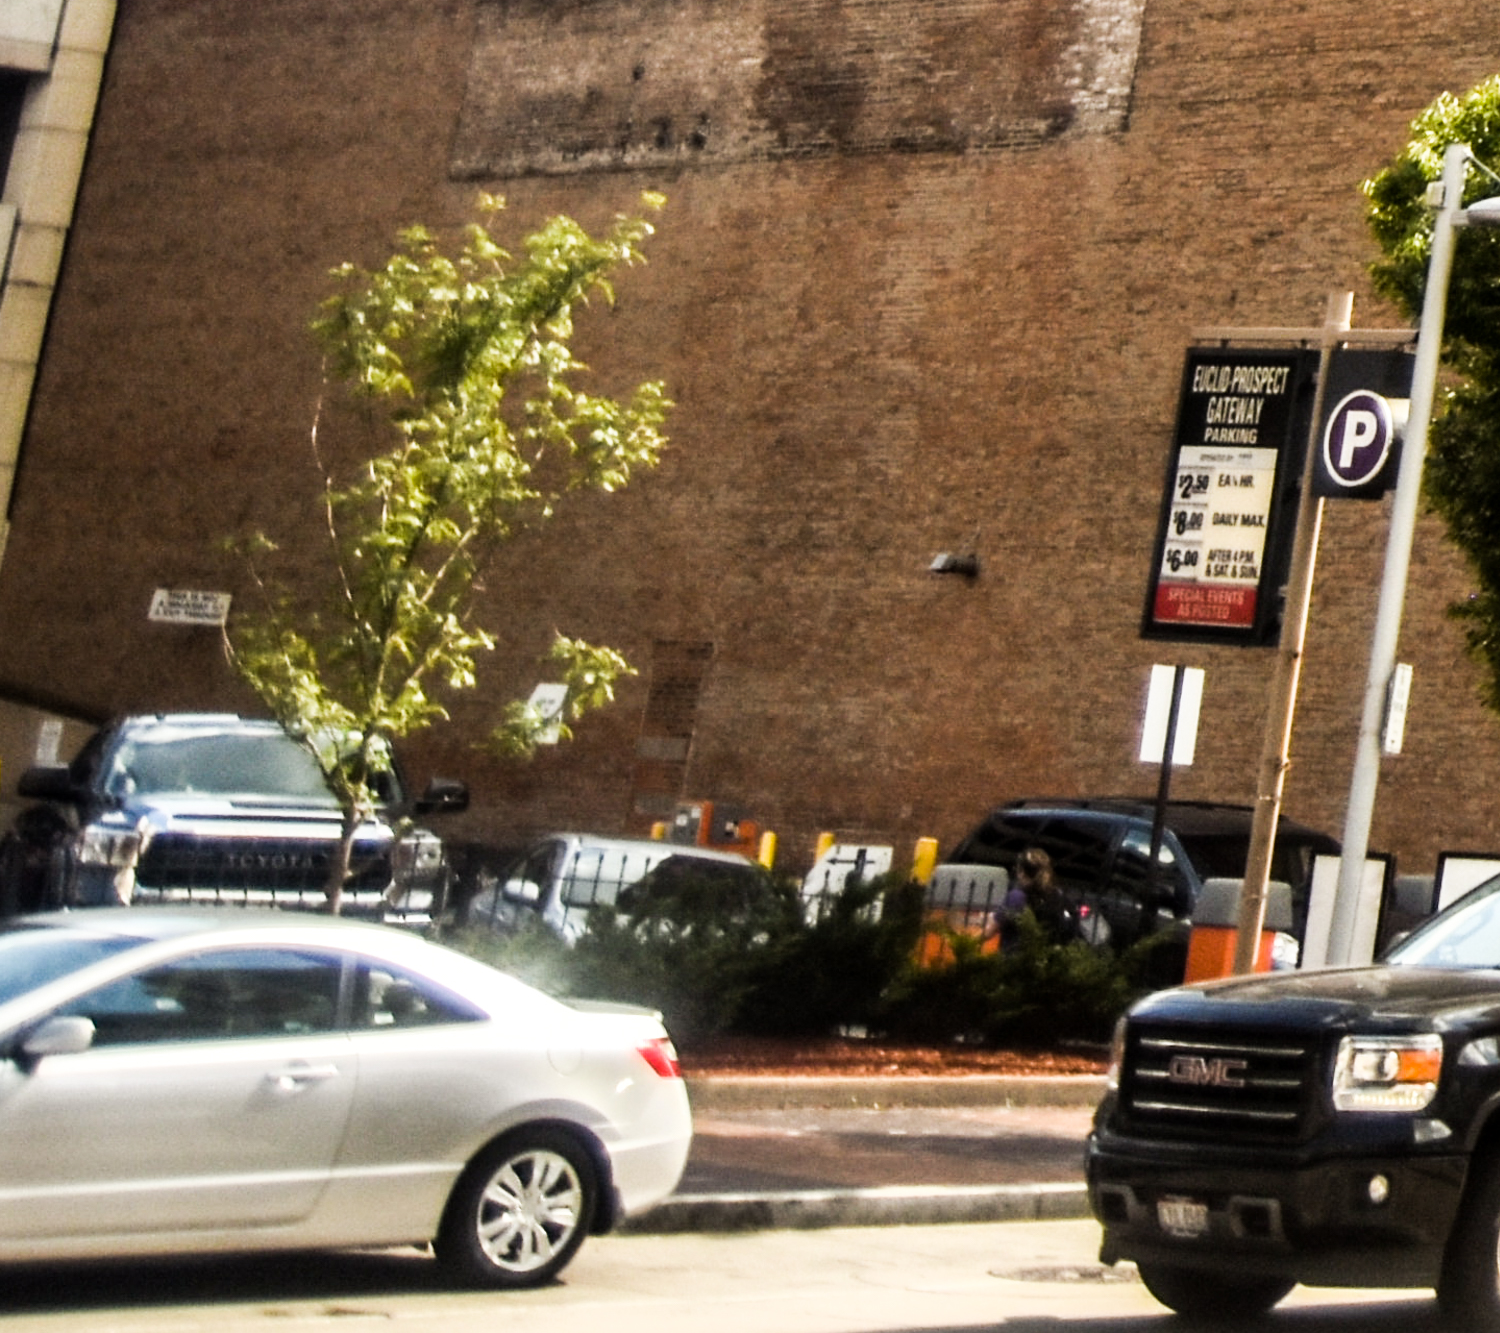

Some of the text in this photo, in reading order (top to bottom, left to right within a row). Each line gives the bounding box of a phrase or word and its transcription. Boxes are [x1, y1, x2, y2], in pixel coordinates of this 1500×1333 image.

[1206, 396, 1265, 425] GATEWAY
[1203, 427, 1259, 445] PARKING
[1338, 409, 1379, 469] P
[1179, 474, 1210, 500] $2.50
[1173, 511, 1204, 536] $8.00
[1212, 512, 1239, 526] DAILY
[1166, 549, 1199, 572] $6.00
[1207, 549, 1232, 562] AFTER
[1168, 1054, 1248, 1088] GMC
